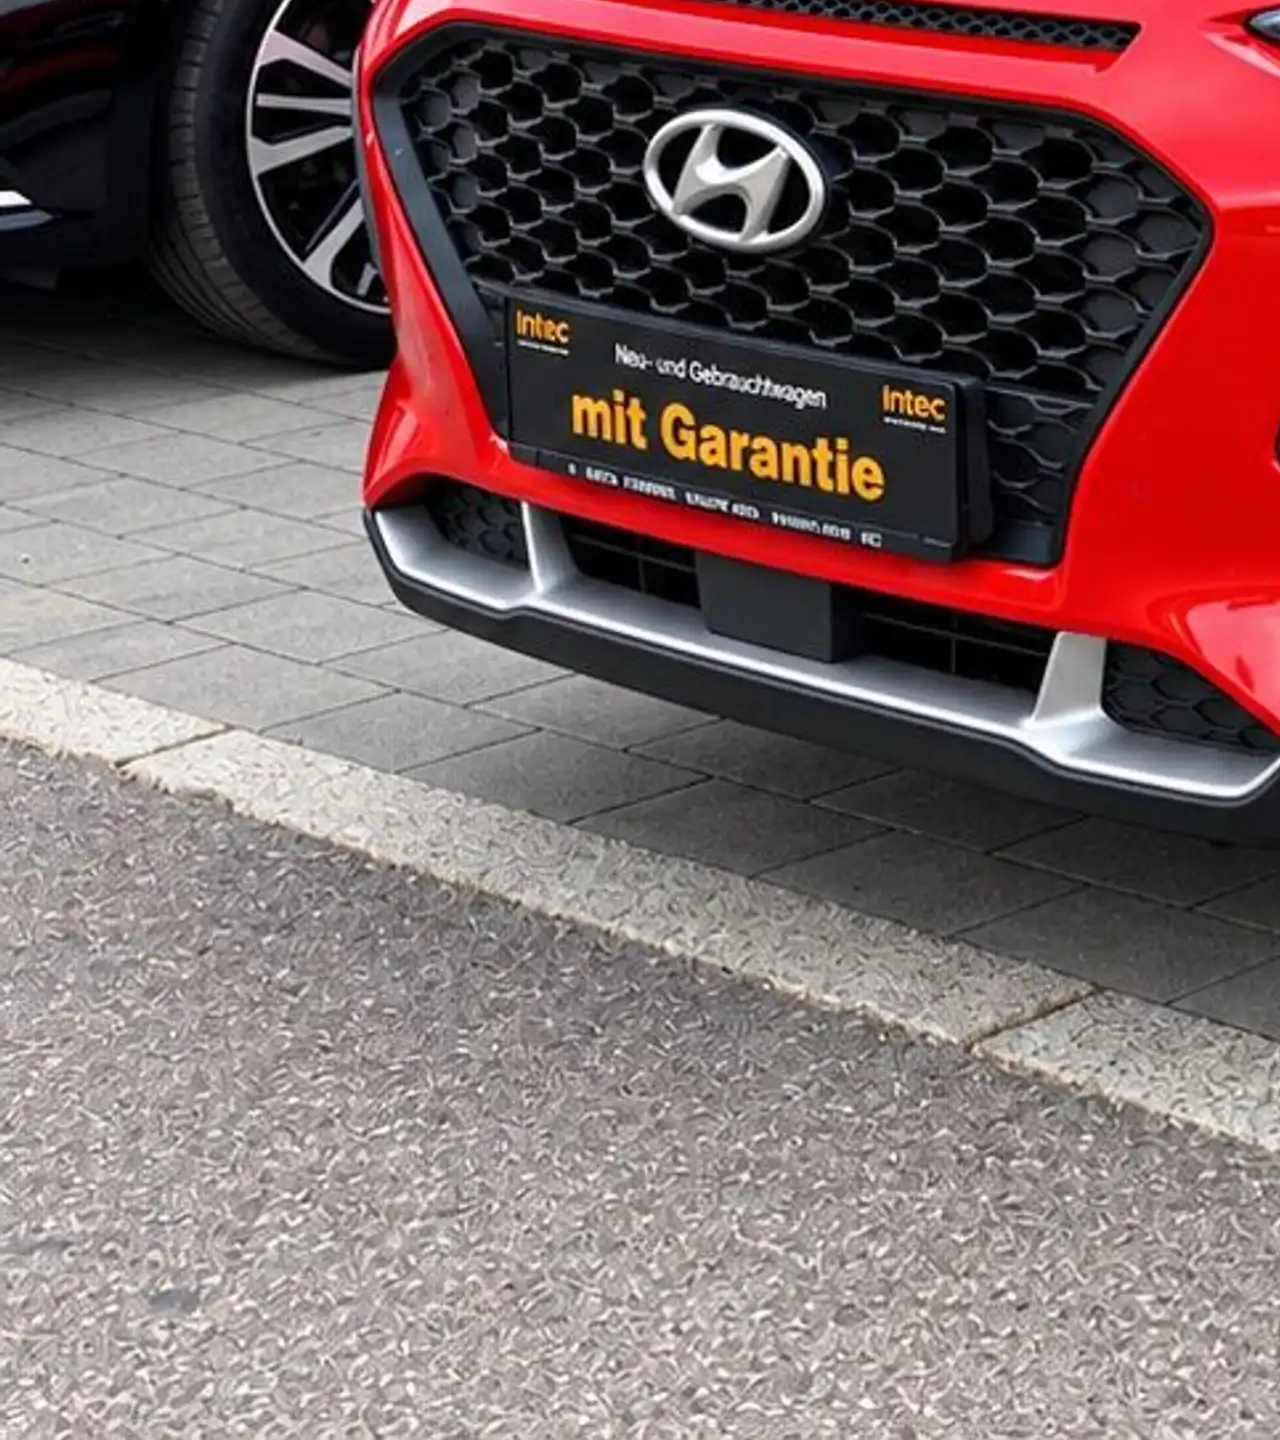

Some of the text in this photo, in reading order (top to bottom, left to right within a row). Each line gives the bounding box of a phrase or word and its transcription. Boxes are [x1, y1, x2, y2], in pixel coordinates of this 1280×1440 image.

[516, 310, 570, 344] Intec
[655, 358, 687, 379] und
[689, 361, 828, 409] Gebrauchtwagen
[882, 384, 946, 422] Intec
[572, 389, 886, 501] mit Garantie
